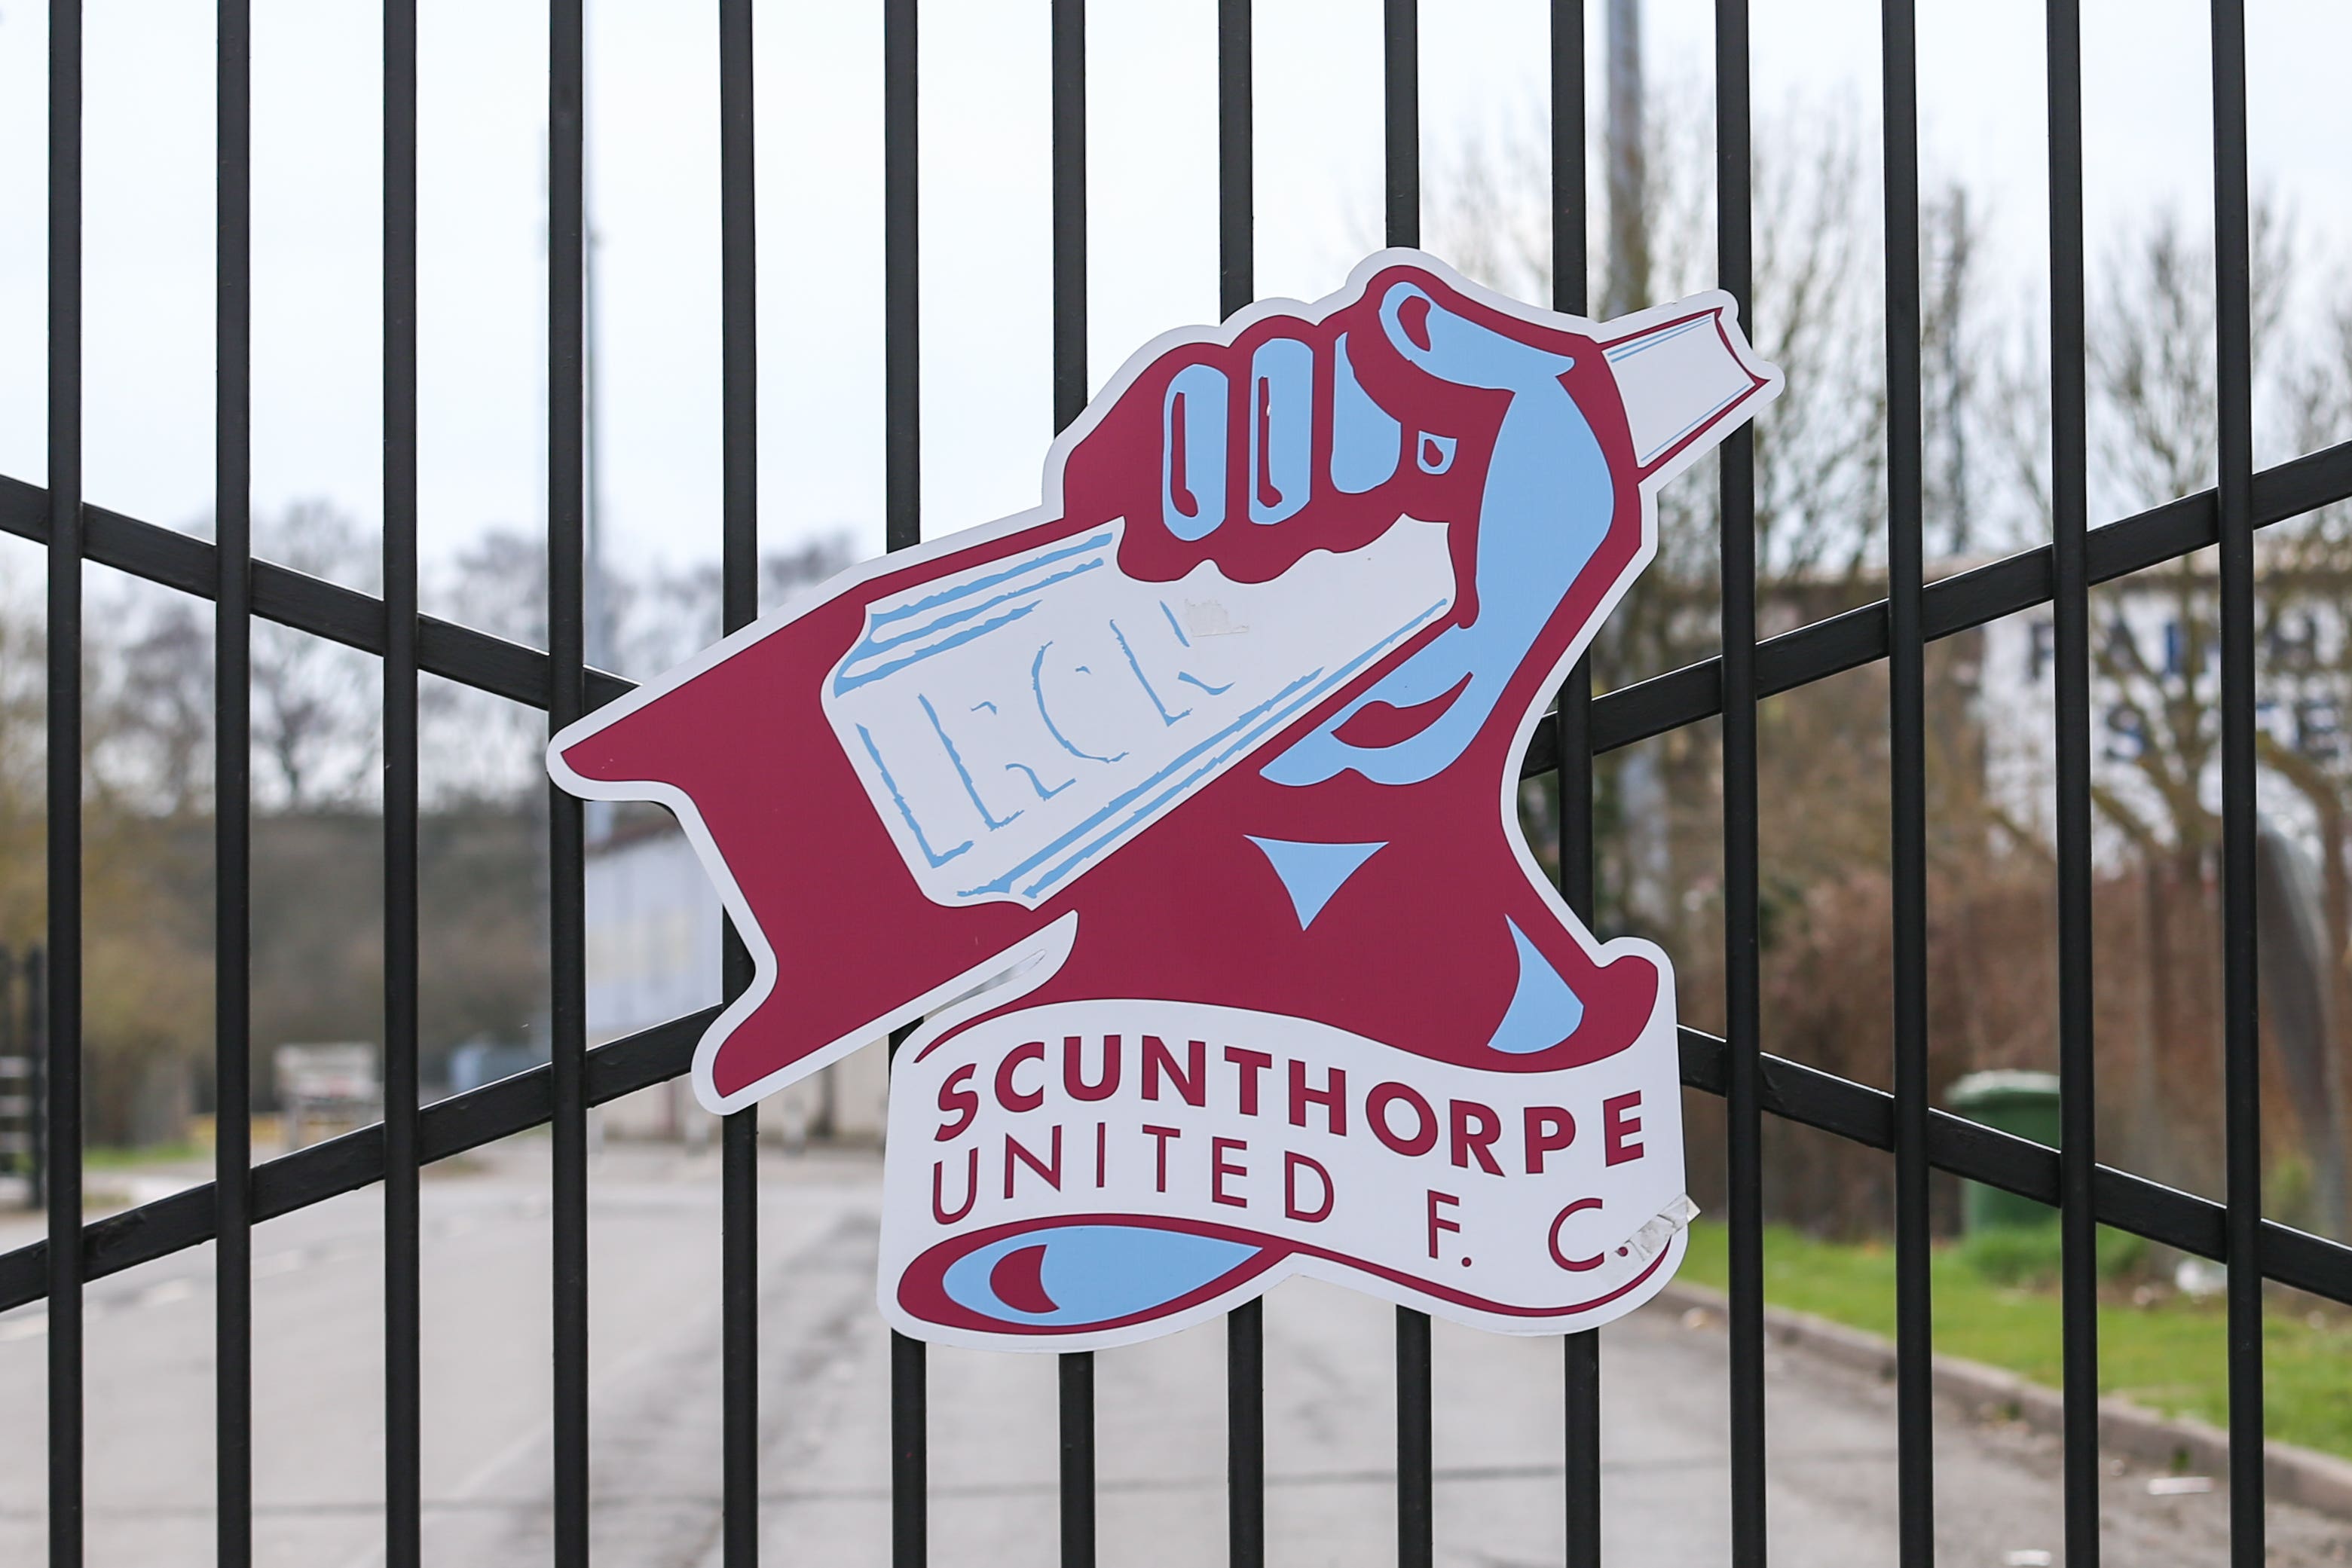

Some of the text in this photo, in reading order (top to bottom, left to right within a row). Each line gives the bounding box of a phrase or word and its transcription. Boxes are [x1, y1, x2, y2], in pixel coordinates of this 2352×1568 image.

[936, 1035, 1644, 1175] SCUNTHORPE
[934, 1123, 1335, 1224] UNITED
[1428, 1191, 1472, 1267] F.
